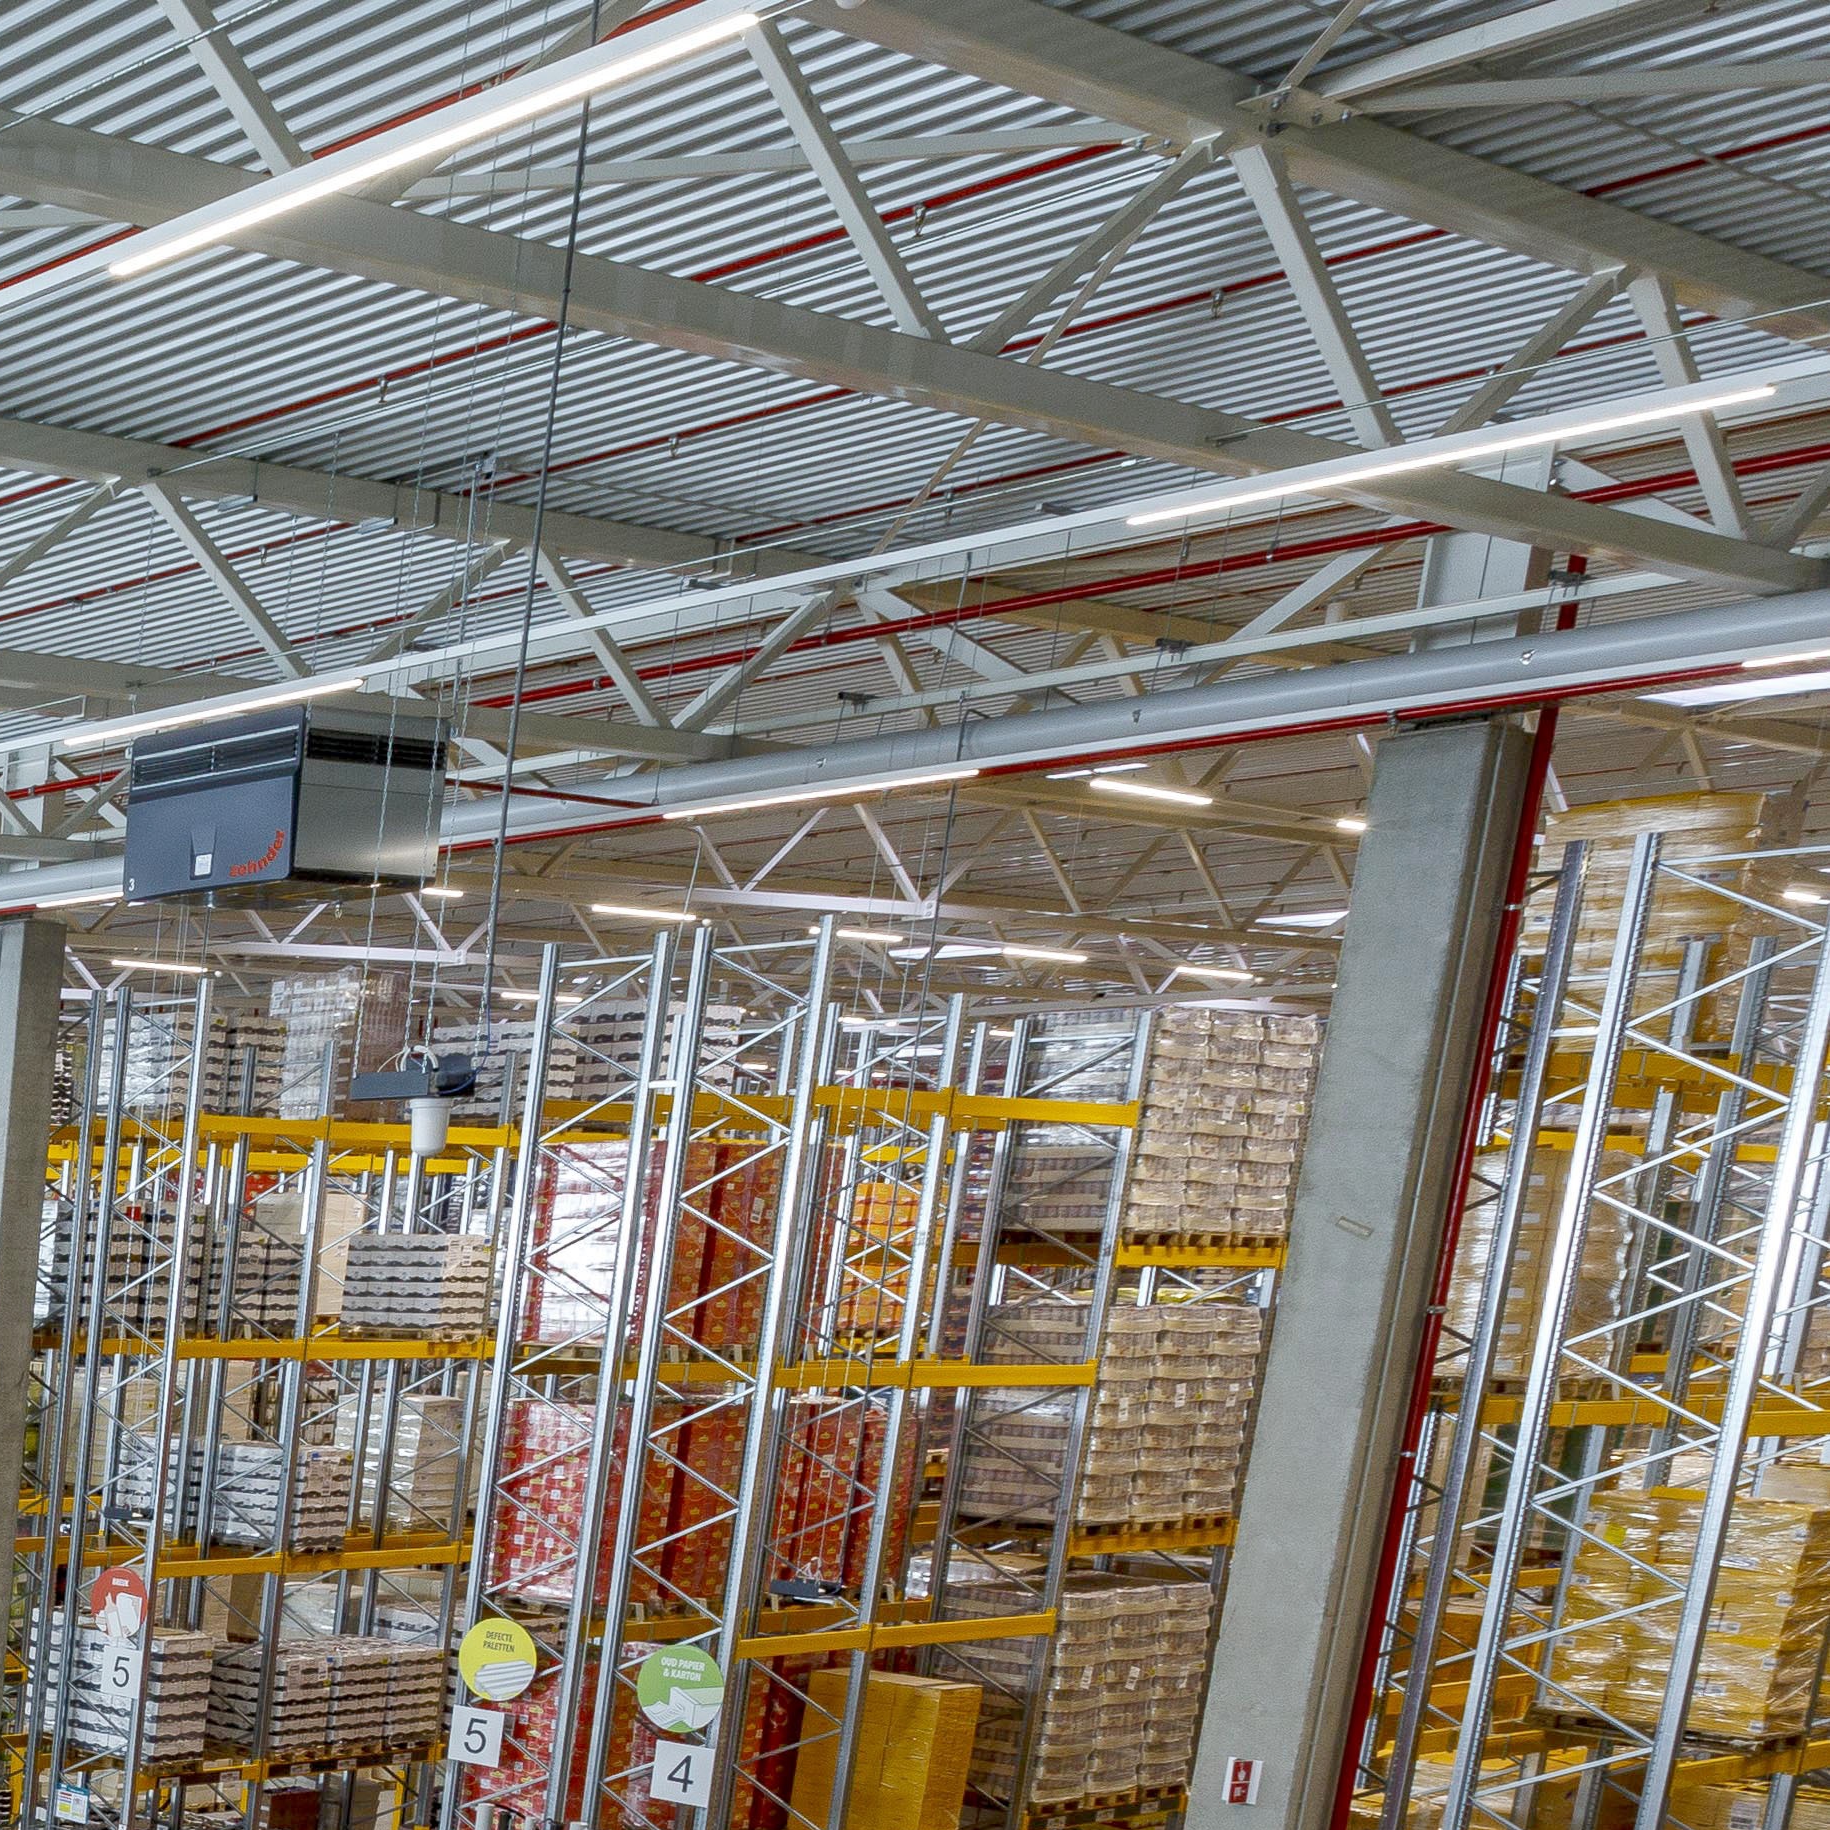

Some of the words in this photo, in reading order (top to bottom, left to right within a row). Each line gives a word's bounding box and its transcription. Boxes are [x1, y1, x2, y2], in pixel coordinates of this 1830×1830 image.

[483, 1640, 515, 1654] PALETTEN
[112, 1656, 130, 1688] 5
[661, 1656, 677, 1670] OUD
[678, 1658, 705, 1672] PAPIER
[669, 1669, 701, 1682] KARTON
[463, 1718, 488, 1754] 5
[667, 1755, 694, 1794] 4
